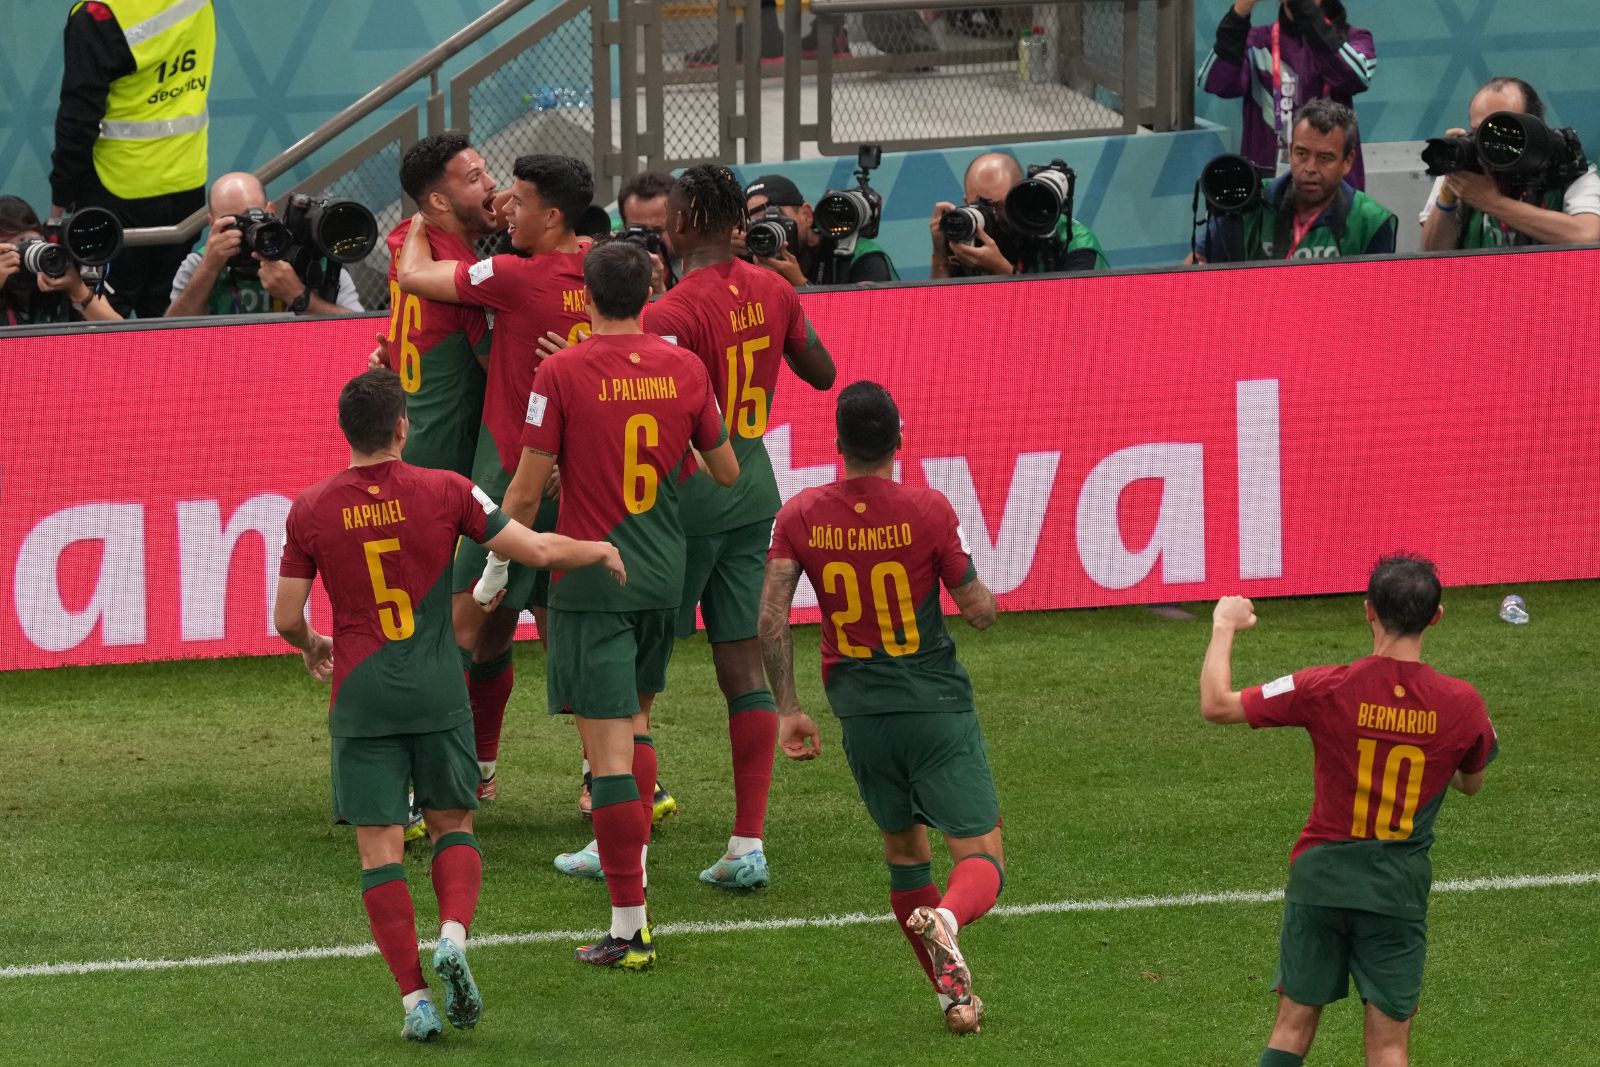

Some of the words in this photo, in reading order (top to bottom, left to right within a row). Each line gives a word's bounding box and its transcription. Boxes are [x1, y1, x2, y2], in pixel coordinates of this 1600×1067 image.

[612, 376, 678, 401] PALHINHA
[725, 335, 770, 440] 15
[623, 413, 659, 515] 6
[763, 378, 1284, 609] tval
[342, 499, 406, 531] RAPHAEL
[808, 523, 843, 551] JOÃO
[847, 522, 912, 551] CANCELO
[363, 537, 415, 641] 5
[822, 561, 920, 659] 20
[1357, 702, 1438, 735] BERNARDO
[1351, 738, 1426, 841] 10
